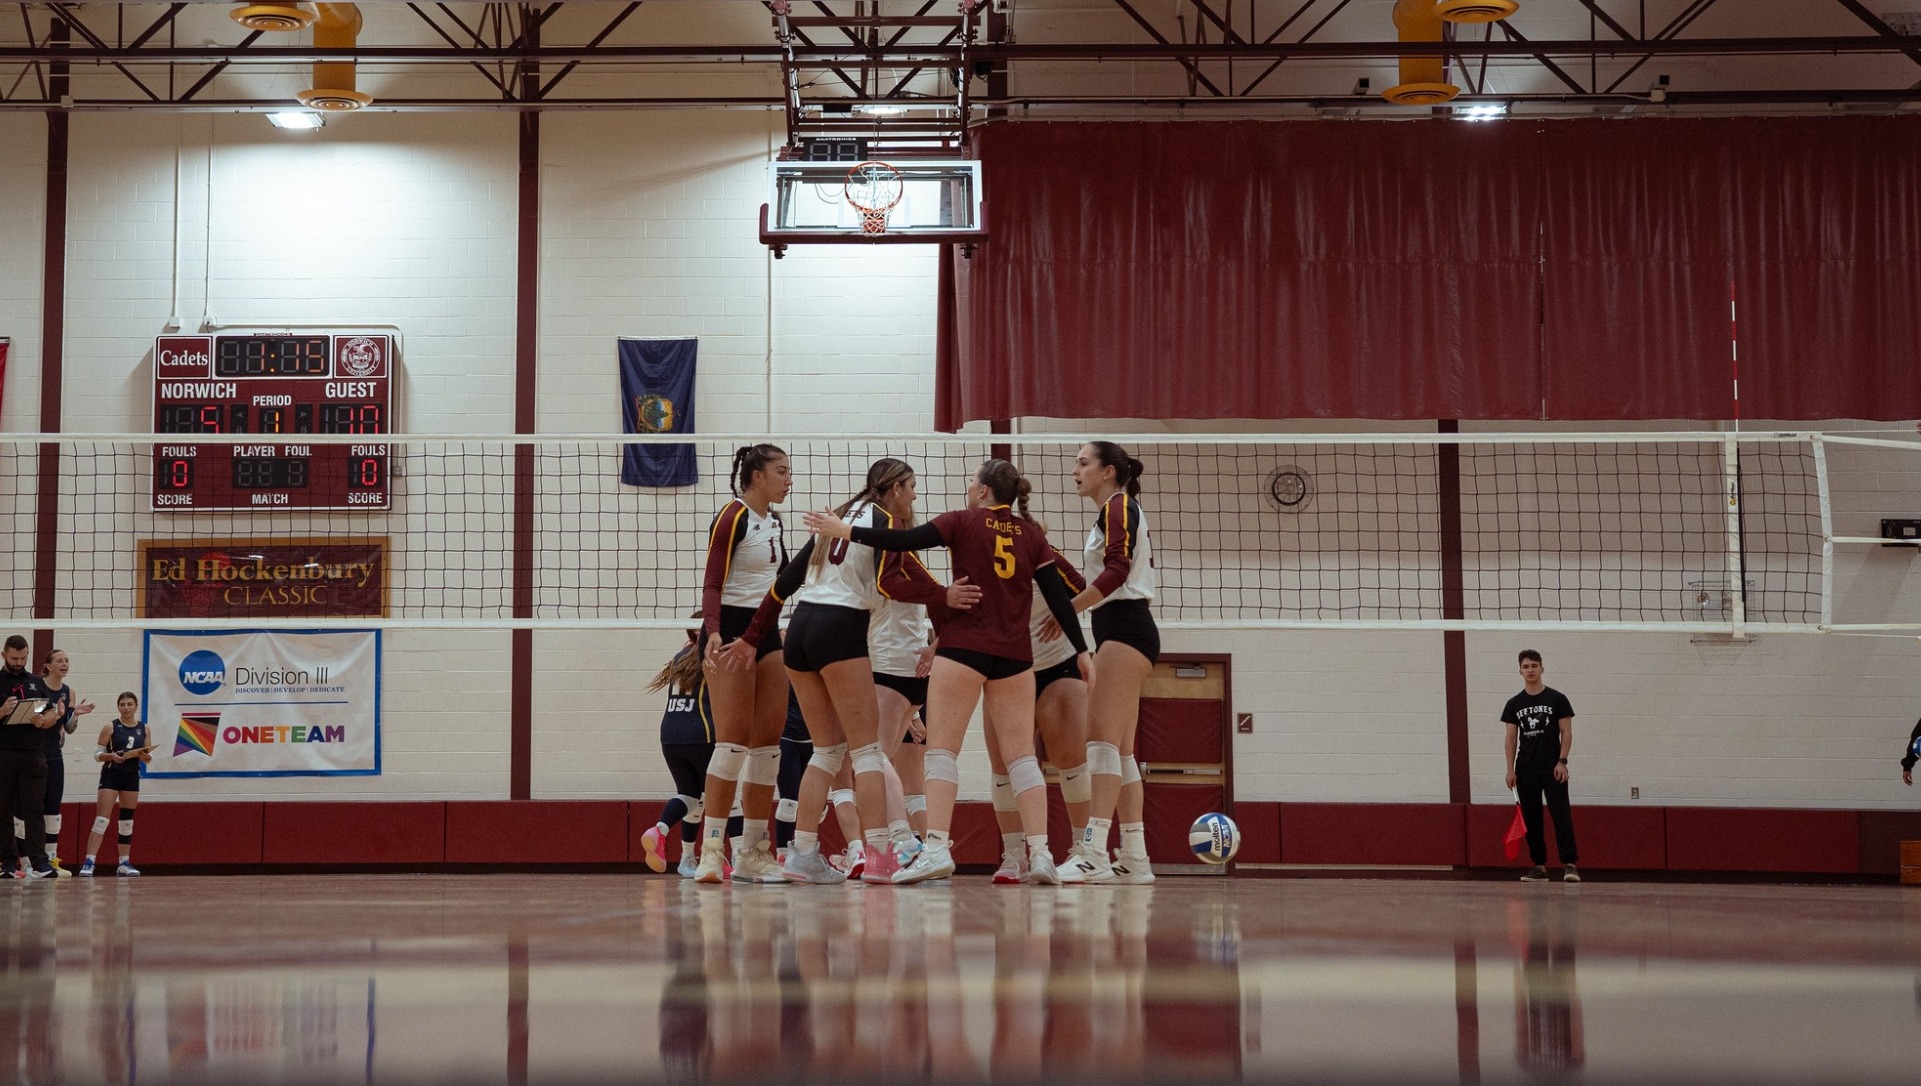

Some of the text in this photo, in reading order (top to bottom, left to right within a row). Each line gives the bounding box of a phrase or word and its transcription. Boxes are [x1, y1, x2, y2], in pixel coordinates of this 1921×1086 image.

[160, 351, 208, 366] Cadets
[161, 383, 237, 399] NORWICH
[325, 382, 377, 398] GUEST
[253, 395, 292, 406] PERIOD
[162, 446, 197, 457] FOULS
[233, 446, 313, 457] PLAYER FOUL
[351, 445, 386, 456] FOULS
[172, 460, 188, 487] 0
[361, 459, 377, 486] 0
[157, 494, 192, 505] SCORE
[252, 494, 288, 504] MATCH
[348, 493, 382, 504] SCORE
[993, 534, 1016, 579] 5
[152, 556, 374, 588] Ed Hockenbury
[223, 586, 328, 605] CLASSIC
[183, 671, 225, 684] NCAA
[236, 667, 328, 685] Division III
[667, 698, 695, 713] USJ
[126, 735, 135, 749] 3
[223, 725, 345, 744] ONETEAM
[1212, 822, 1221, 851] molten
